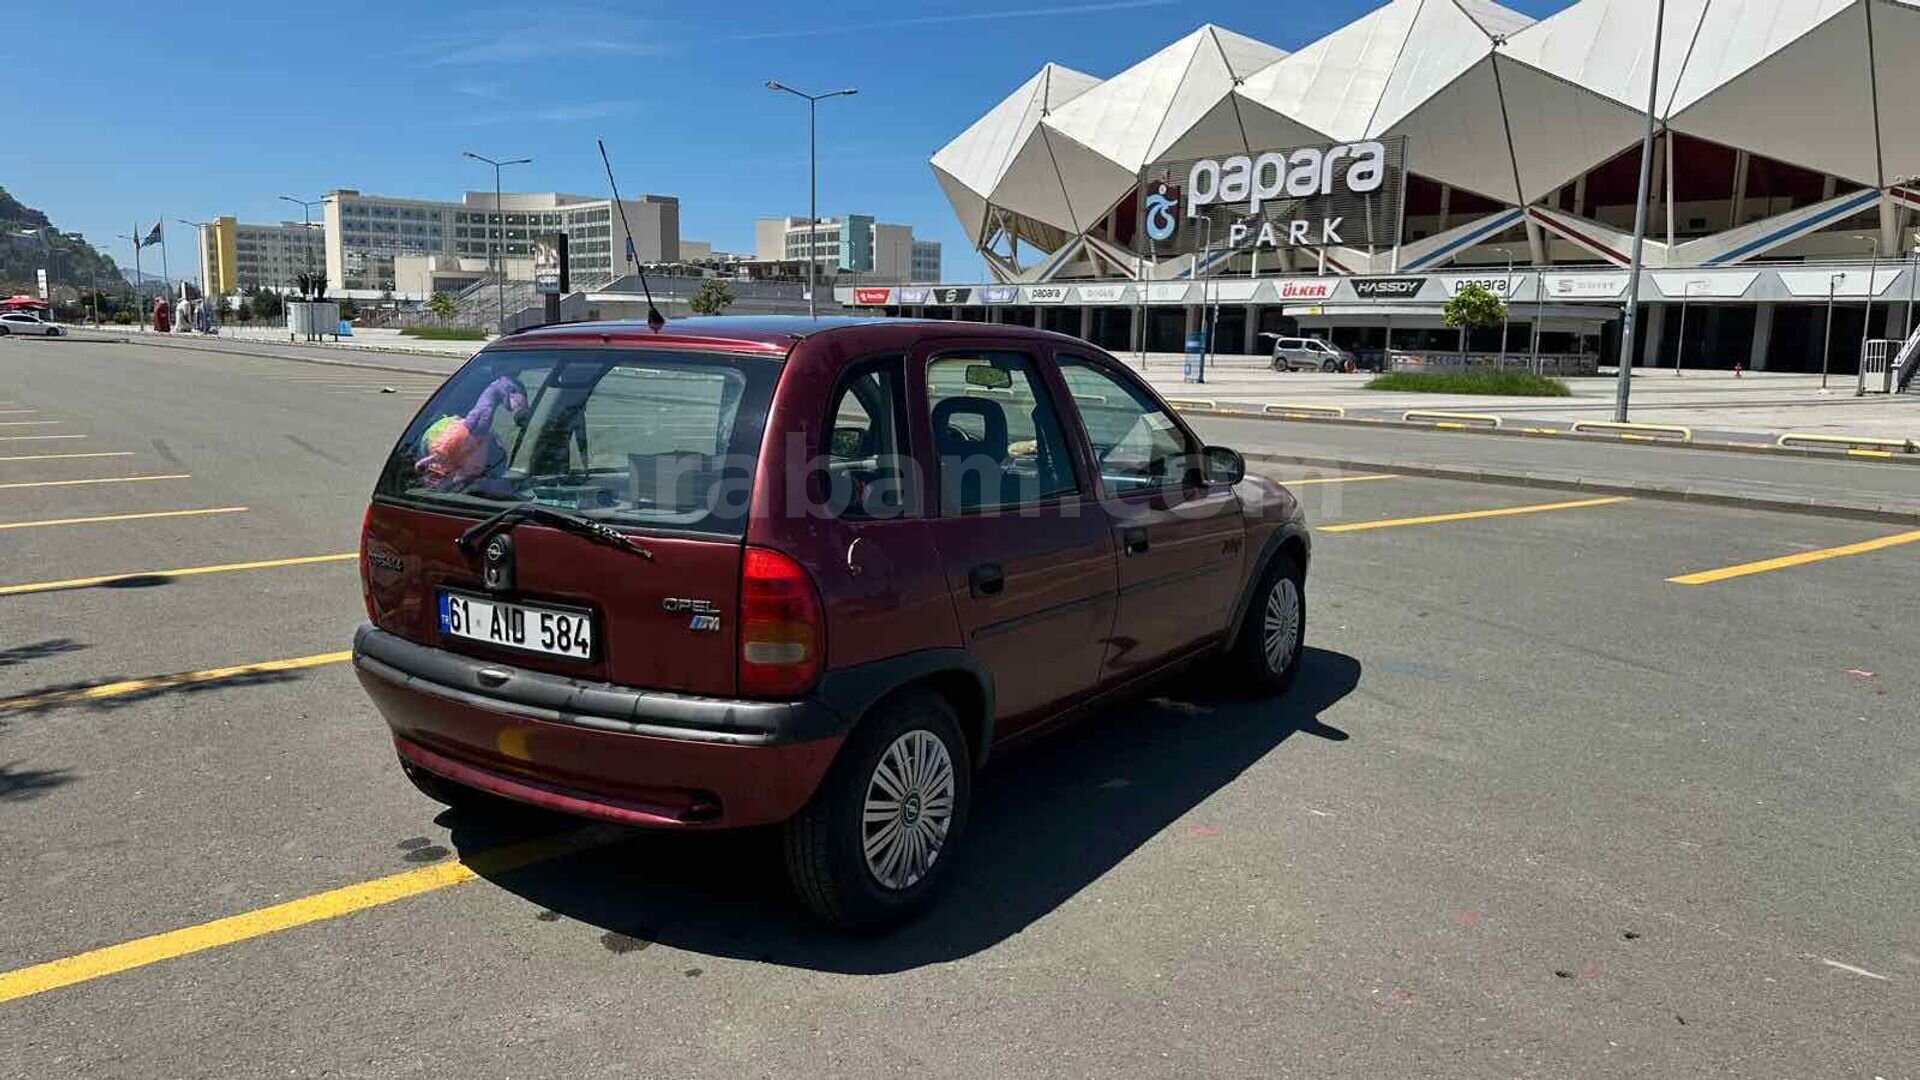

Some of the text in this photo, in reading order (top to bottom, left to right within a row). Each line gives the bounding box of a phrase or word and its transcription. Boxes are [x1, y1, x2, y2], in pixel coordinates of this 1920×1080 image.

[1187, 141, 1385, 218] papara
[1229, 217, 1344, 248] PARK
[1032, 288, 1061, 299] papara
[1282, 282, 1327, 297] ÜLKER
[1357, 281, 1419, 293] HASSOY
[662, 597, 721, 612] OPEL
[450, 597, 589, 655] 61 AID 584
